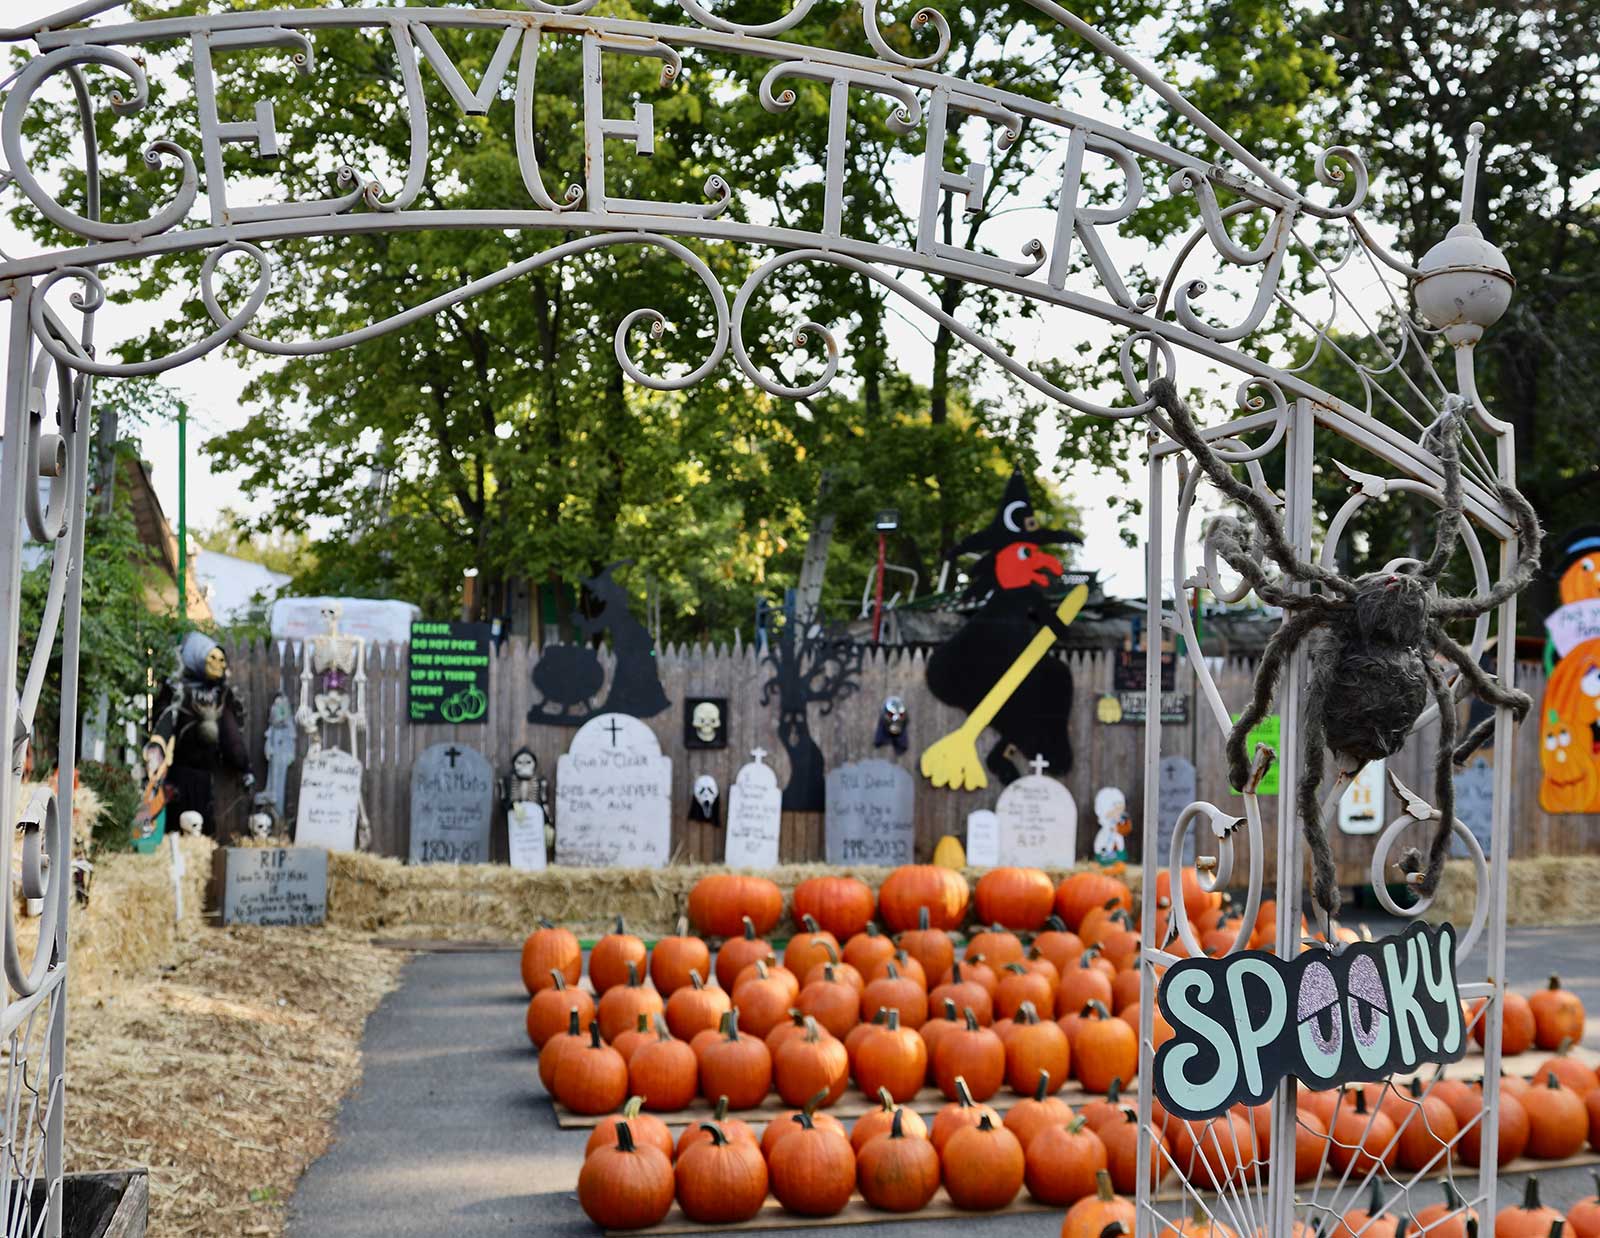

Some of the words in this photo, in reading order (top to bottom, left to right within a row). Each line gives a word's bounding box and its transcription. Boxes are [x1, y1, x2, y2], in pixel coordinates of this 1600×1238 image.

[1, 20, 1294, 342] CEMETERY
[411, 638, 427, 650] DO
[428, 639, 450, 650] NOT
[410, 669, 426, 681] UP
[427, 670, 442, 681] BY
[1120, 692, 1185, 713] WELME
[260, 850, 287, 869] RIP
[1162, 930, 1461, 1112] SPOOKY
